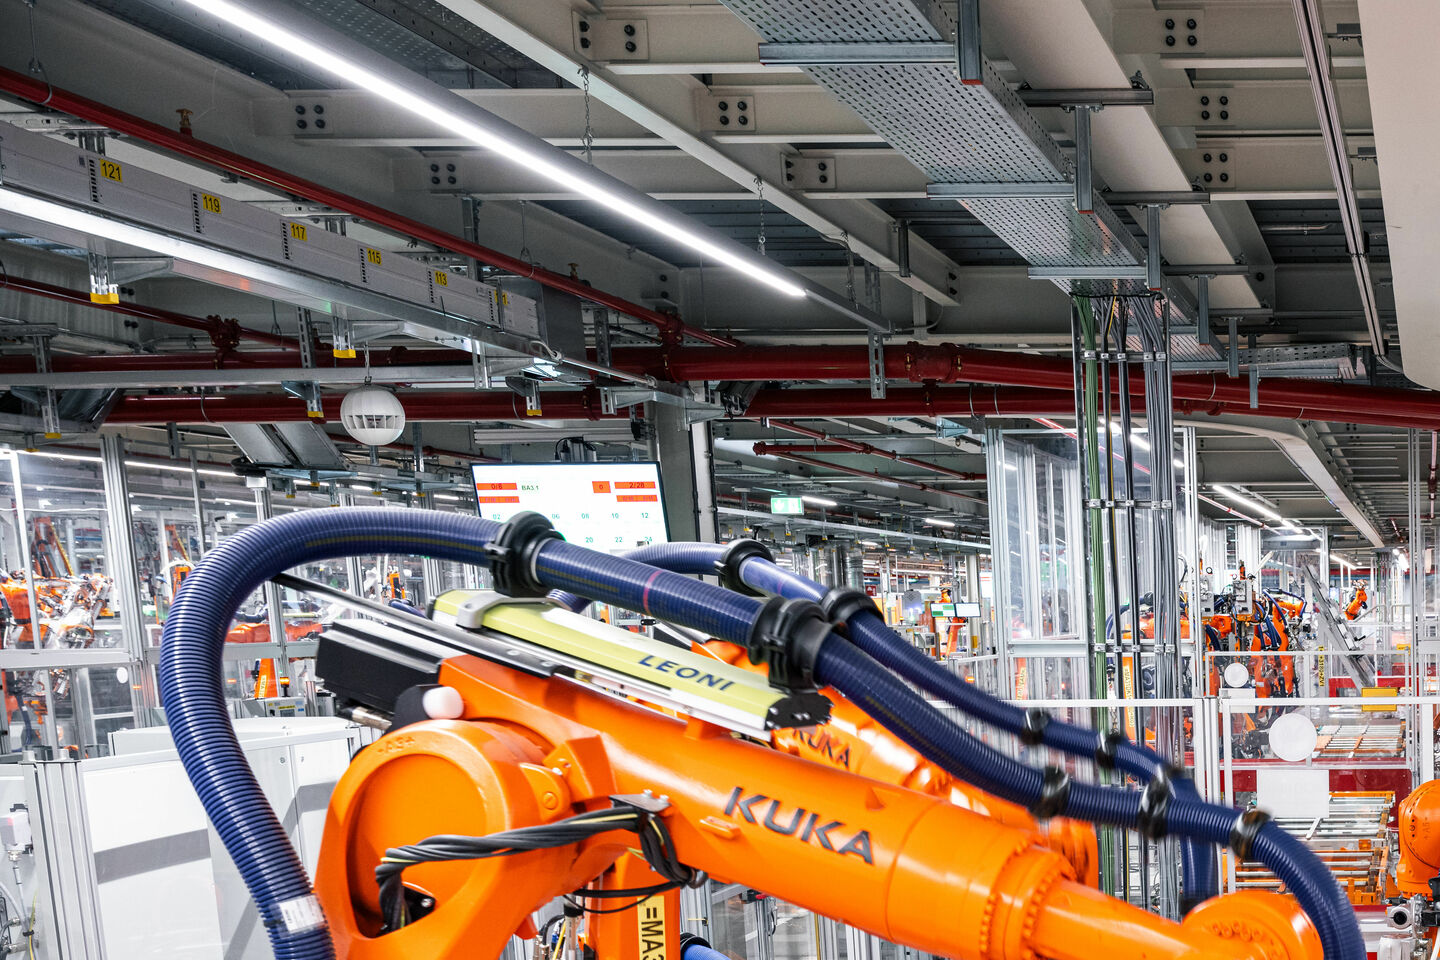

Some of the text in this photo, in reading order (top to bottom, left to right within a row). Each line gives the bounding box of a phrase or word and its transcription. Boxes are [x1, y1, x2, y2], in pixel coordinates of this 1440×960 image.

[102, 162, 121, 181] 121
[203, 194, 221, 213] 119
[291, 224, 307, 240] 117
[368, 249, 382, 265] 115
[435, 271, 448, 286] 113
[638, 655, 734, 691] LEONI
[724, 786, 875, 865] KUKA
